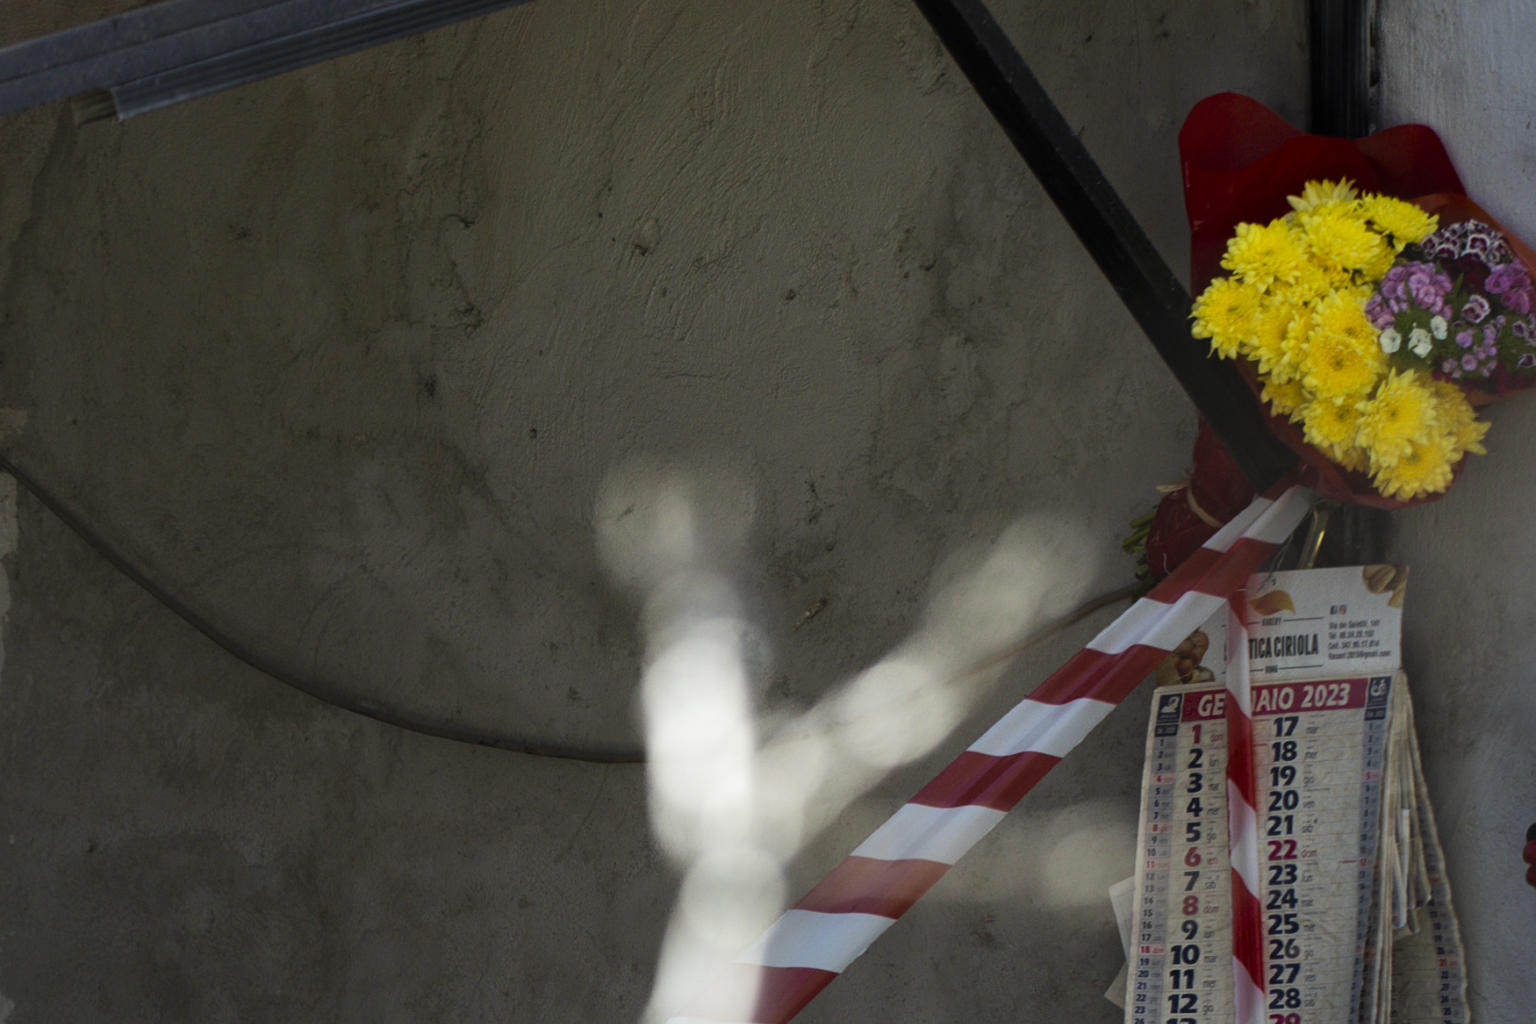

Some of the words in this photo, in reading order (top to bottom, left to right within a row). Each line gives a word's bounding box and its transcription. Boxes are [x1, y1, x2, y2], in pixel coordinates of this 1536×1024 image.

[1273, 633, 1319, 658] CIRIOLA
[1197, 687, 1295, 718] GEAIO
[1300, 682, 1351, 708] 2023
[1191, 724, 1202, 745] 1
[1273, 716, 1299, 738] 17
[1187, 748, 1204, 769] 2
[1271, 740, 1298, 762] 18
[1187, 772, 1203, 793] 3
[1270, 765, 1296, 787] 19
[1185, 796, 1203, 817] 4
[1268, 789, 1299, 812] 20
[1153, 811, 1159, 820] 7
[1266, 814, 1294, 836] 21
[1185, 821, 1202, 843] 5
[1184, 846, 1201, 867] 6
[1267, 839, 1298, 861] 22
[1183, 870, 1200, 892] 7
[1268, 863, 1298, 886] 23
[1181, 895, 1199, 916] 8
[1266, 888, 1299, 910] 24
[1143, 909, 1153, 918] 15
[1268, 913, 1300, 935] 25
[1142, 921, 1152, 930] 16
[1181, 919, 1198, 941] 9
[1141, 933, 1152, 942] 17
[1140, 945, 1151, 954] 18
[1170, 944, 1201, 965] 10
[1269, 938, 1300, 960] 26
[1140, 958, 1150, 966] 19
[1138, 969, 1150, 979] 20
[1169, 968, 1195, 989] 11
[1269, 962, 1301, 985] 27
[1137, 982, 1148, 991] 21
[1135, 994, 1147, 1003] 22
[1167, 992, 1198, 1014] 12
[1268, 987, 1302, 1010] 28
[1134, 1006, 1146, 1015] 23
